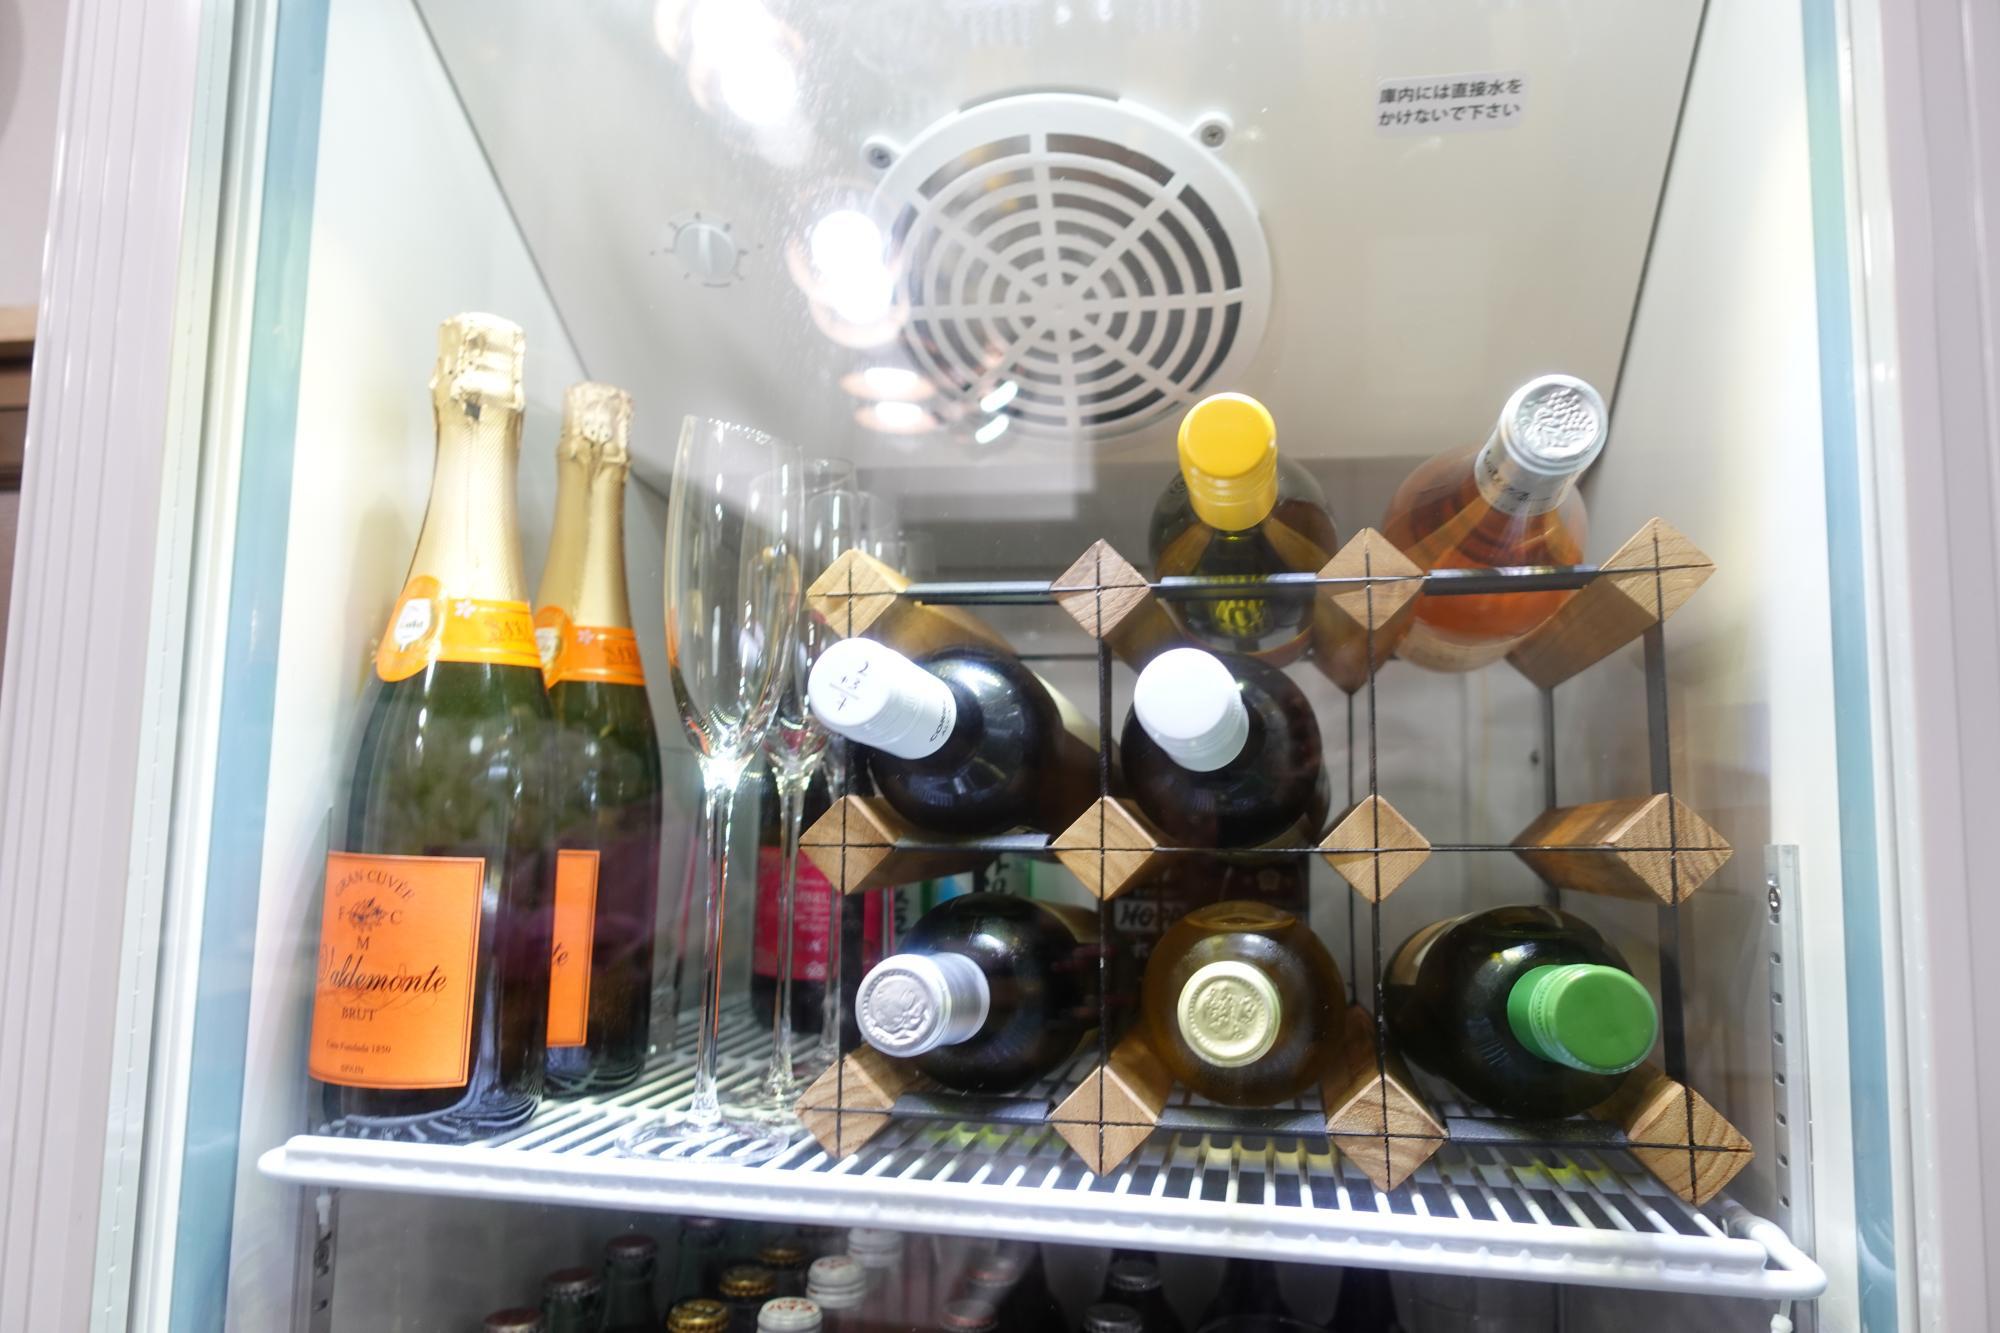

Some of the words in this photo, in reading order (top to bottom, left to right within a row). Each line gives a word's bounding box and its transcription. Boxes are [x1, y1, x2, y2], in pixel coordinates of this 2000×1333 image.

[1379, 78, 1523, 104] 庫内には直接水を
[1378, 103, 1520, 126] かけないで下さい
[335, 868, 364, 898] GRAN
[356, 936, 371, 950] M
[318, 943, 448, 994] Valdemonte
[341, 1007, 377, 1022] BRUT
